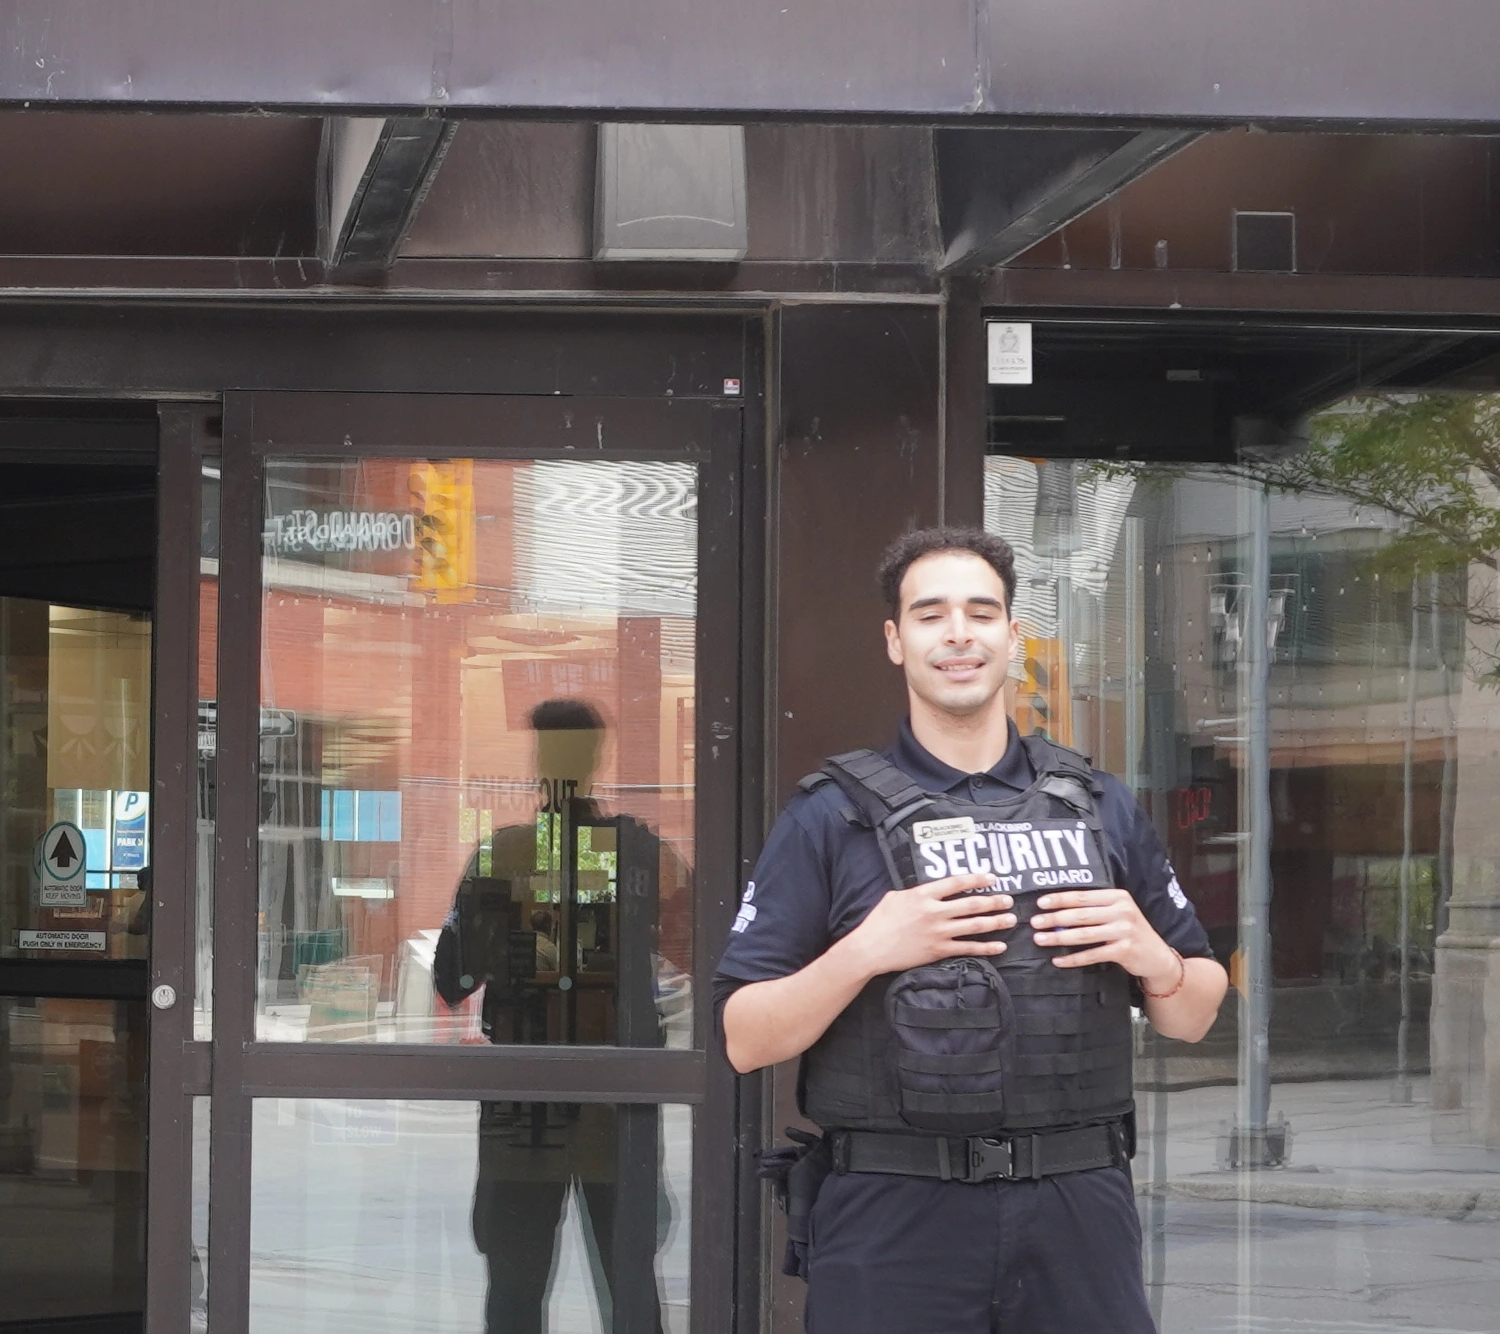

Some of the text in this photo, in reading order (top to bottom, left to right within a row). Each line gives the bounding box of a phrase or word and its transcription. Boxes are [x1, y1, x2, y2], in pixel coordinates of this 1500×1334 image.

[124, 792, 139, 812] P
[919, 830, 1090, 879] SECURITY
[1032, 869, 1094, 886] GUARD
